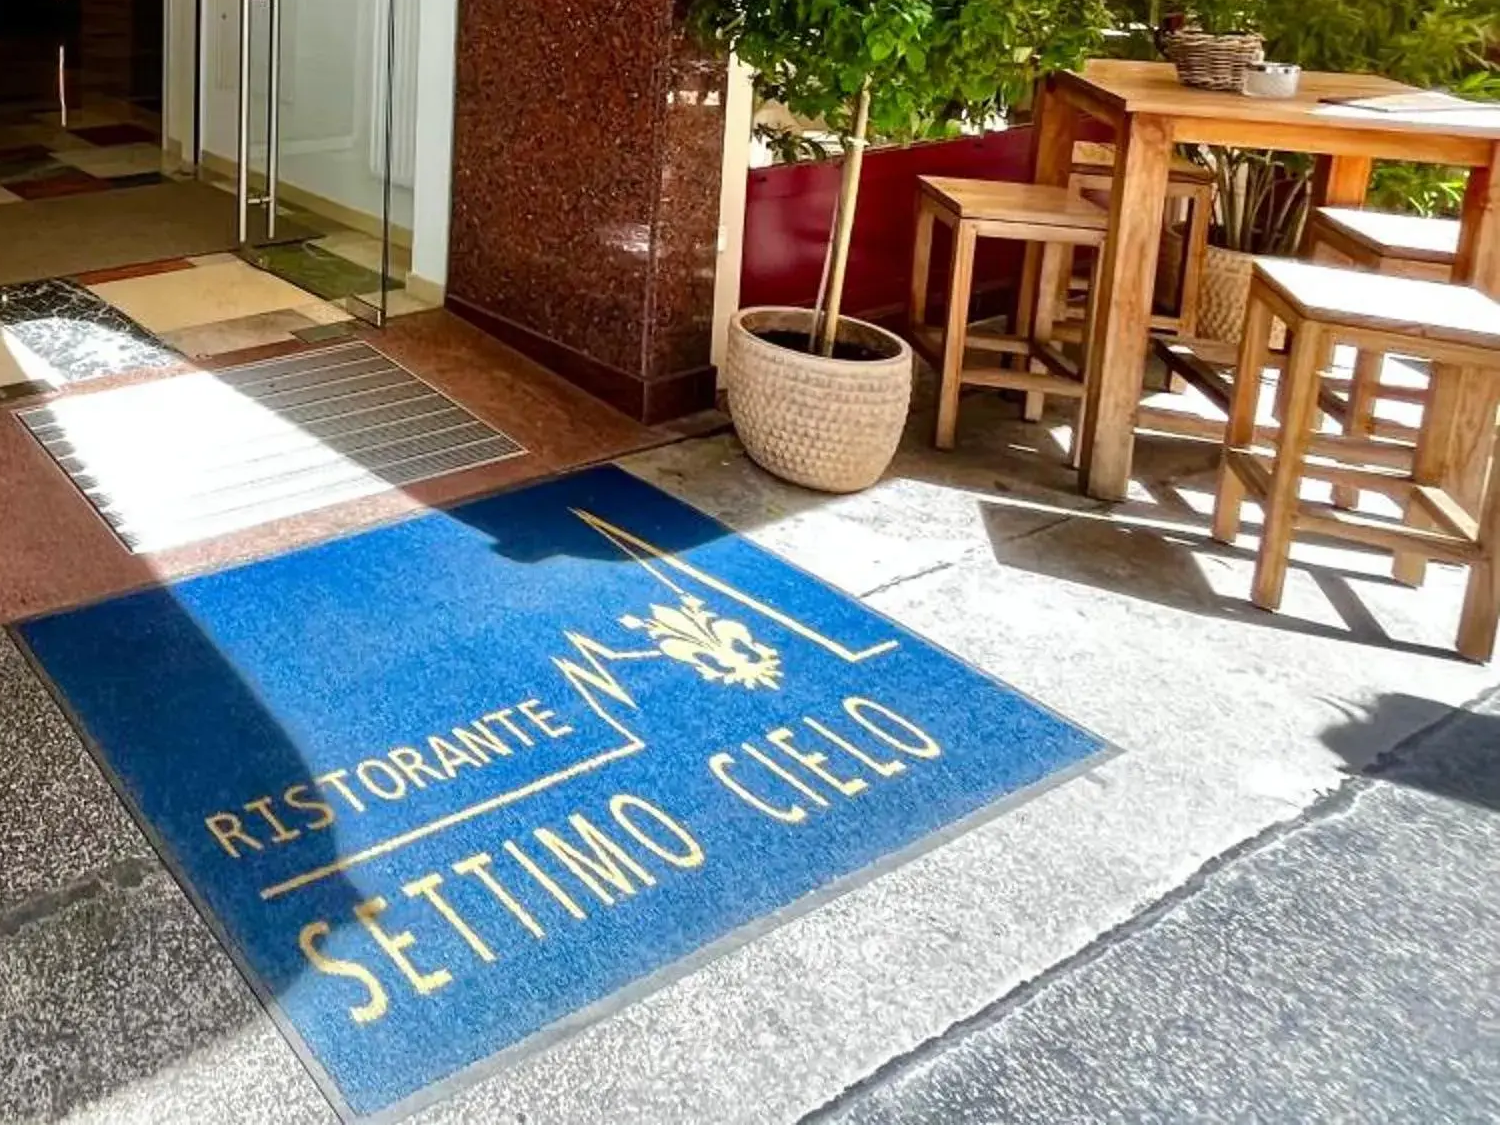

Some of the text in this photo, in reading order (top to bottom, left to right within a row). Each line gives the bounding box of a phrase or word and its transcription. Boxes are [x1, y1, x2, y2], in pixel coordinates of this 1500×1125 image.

[205, 698, 573, 858] RISTORANTE
[299, 695, 942, 1023] SETTIMO CIELO
